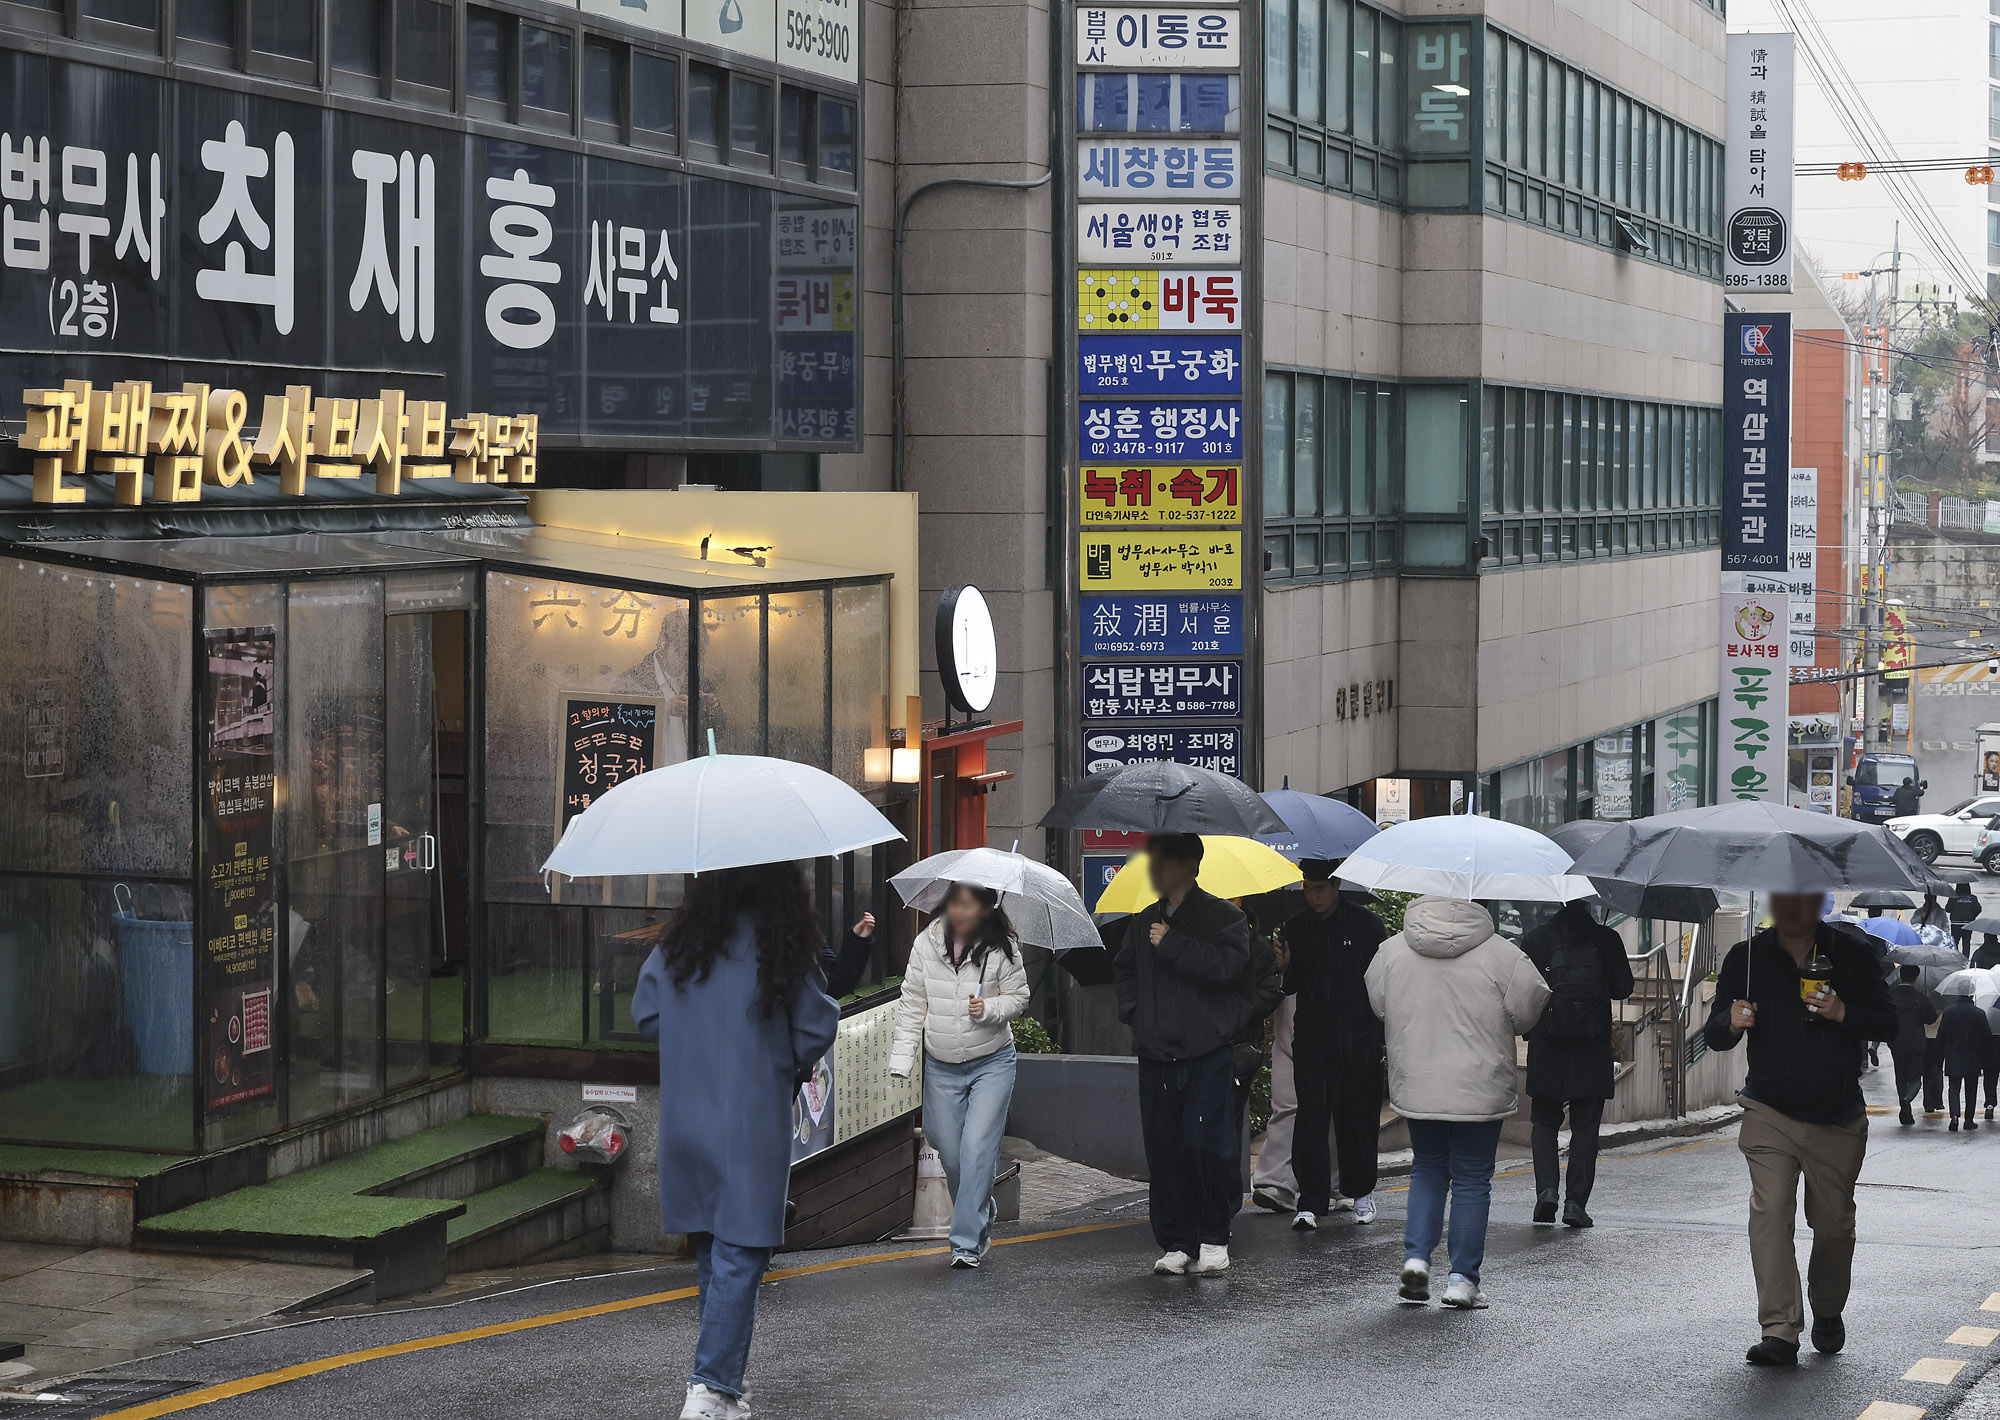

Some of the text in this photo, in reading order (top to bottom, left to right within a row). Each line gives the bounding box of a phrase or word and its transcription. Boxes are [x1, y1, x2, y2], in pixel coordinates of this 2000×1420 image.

[787, 9, 850, 64] 596-3900
[1086, 11, 1107, 62] 법무사
[1117, 14, 1228, 49] 이동윤
[1414, 31, 1468, 140] 바둑
[1083, 147, 1234, 189] 세창합동
[1750, 149, 1766, 198] 담아서
[1, 131, 165, 282] 법무사
[584, 219, 679, 324] 사무소
[1192, 210, 1231, 228] 협동
[1087, 213, 1183, 249] 서울생약
[1743, 228, 1772, 241] 정담
[1192, 232, 1232, 251] 조합
[1742, 241, 1770, 254] 한식
[1150, 252, 1173, 261] 501호
[1725, 274, 1787, 286] 595-1388
[1163, 276, 1239, 324] 바둑
[48, 280, 118, 340] (2층)
[1083, 348, 1239, 382] 법무법인 무궁화
[1098, 376, 1129, 386] 205호
[1084, 407, 1240, 439] 성훈 행정사
[1113, 442, 1185, 454] 3478-9117
[1202, 442, 1233, 454] 301호
[1741, 379, 1769, 544] 역삼검도관
[1790, 473, 1811, 481] 사무소
[1086, 510, 1236, 521] 다인속기사무소 T.02-537-1222
[1118, 543, 1235, 561] 법무사사무소 바로
[1139, 562, 1177, 577] 법무사
[1209, 578, 1233, 587] 203호
[1179, 602, 1231, 613] 법률사무소
[1191, 640, 1220, 651] 201호
[1727, 644, 1779, 658] 본사직영
[1089, 666, 1233, 697] 석탑 법무사
[1088, 698, 1235, 715] 합동 사무소 586-7788
[1094, 739, 1118, 748] 법무사
[1187, 733, 1234, 751] 조미경
[210, 861, 232, 879] 소고기
[256, 856, 269, 871] 세트
